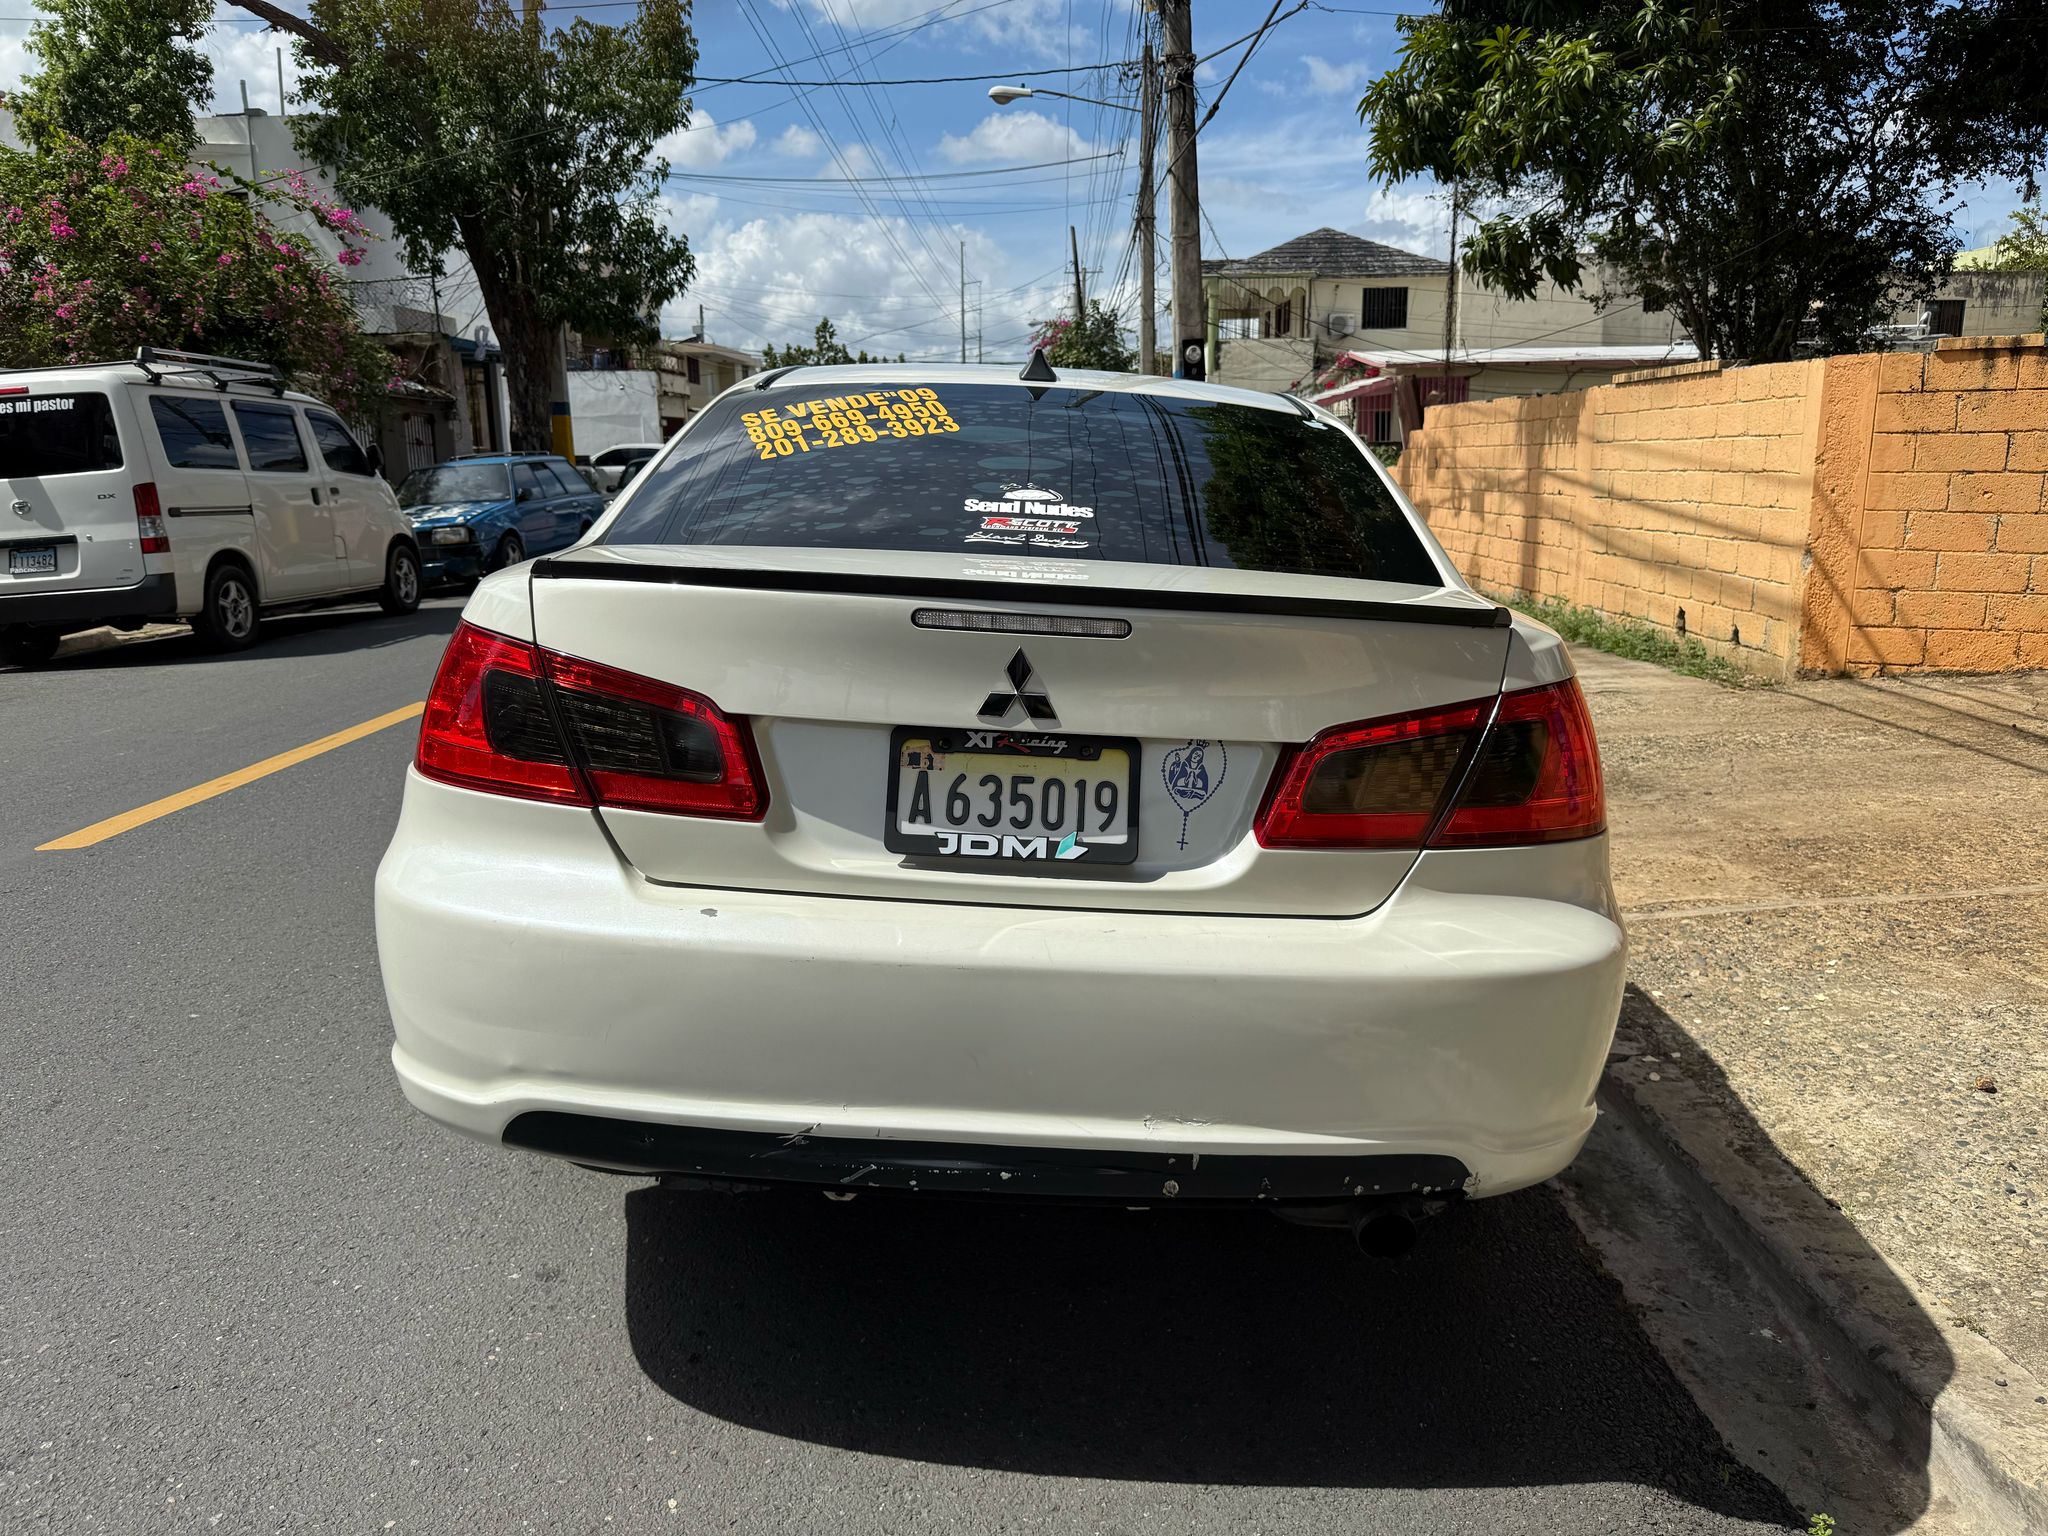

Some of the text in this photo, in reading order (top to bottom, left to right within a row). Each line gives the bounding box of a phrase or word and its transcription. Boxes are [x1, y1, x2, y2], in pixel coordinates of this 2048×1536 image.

[15, 399, 31, 413] mi
[33, 398, 75, 413] pastor
[740, 408, 781, 428] SE
[747, 400, 948, 444] 809-669-4950
[755, 415, 961, 460] 201-289-3923
[964, 498, 1094, 518] Send Nudes
[934, 831, 1050, 860] JDM
